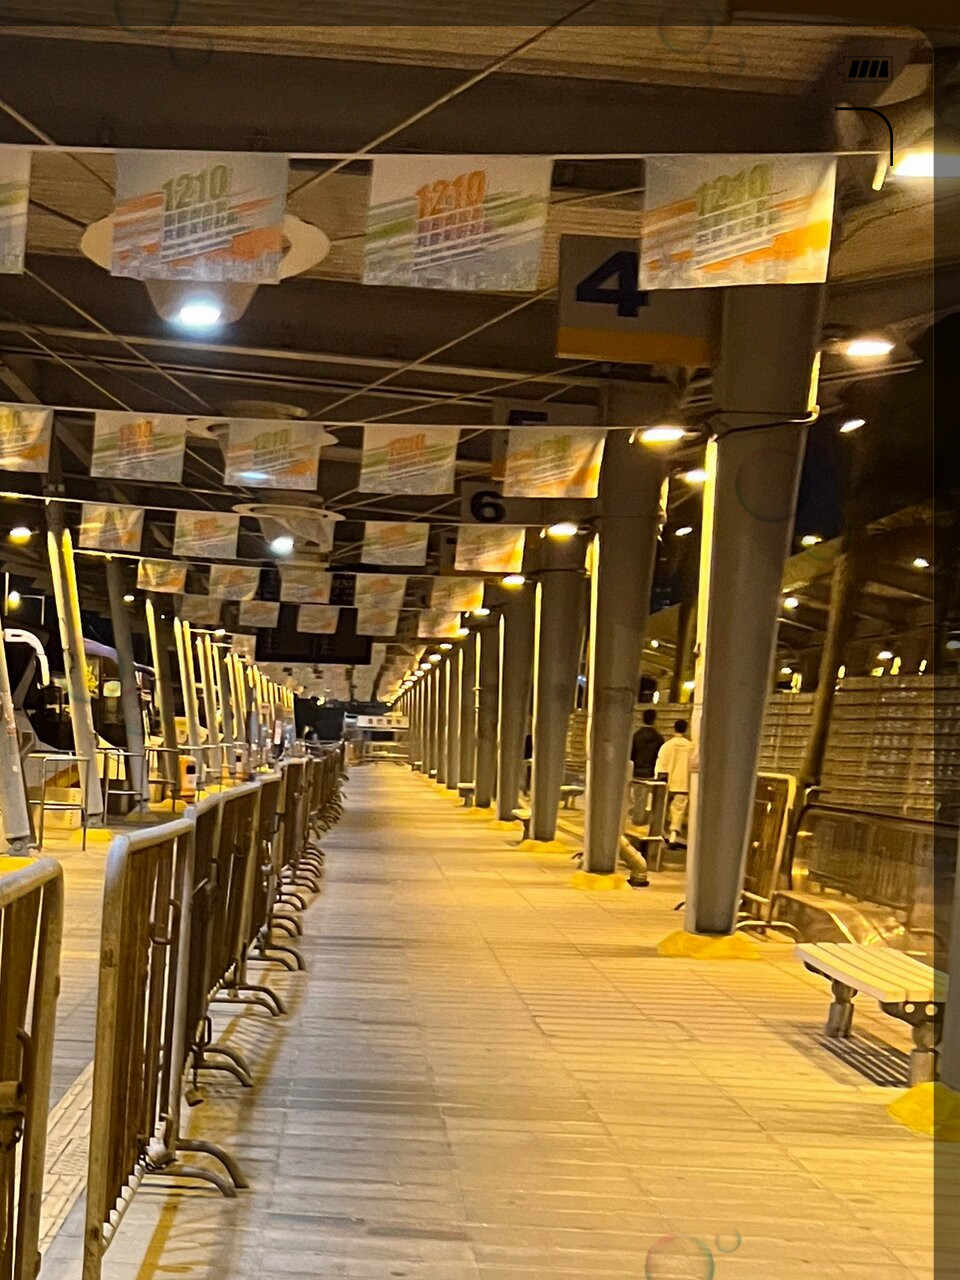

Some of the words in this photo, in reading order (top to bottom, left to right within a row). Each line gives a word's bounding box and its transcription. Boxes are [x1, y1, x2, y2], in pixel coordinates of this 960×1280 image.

[161, 164, 229, 212] 1210
[415, 169, 486, 219] 1210
[576, 250, 648, 317] 4
[470, 490, 506, 522] 6
